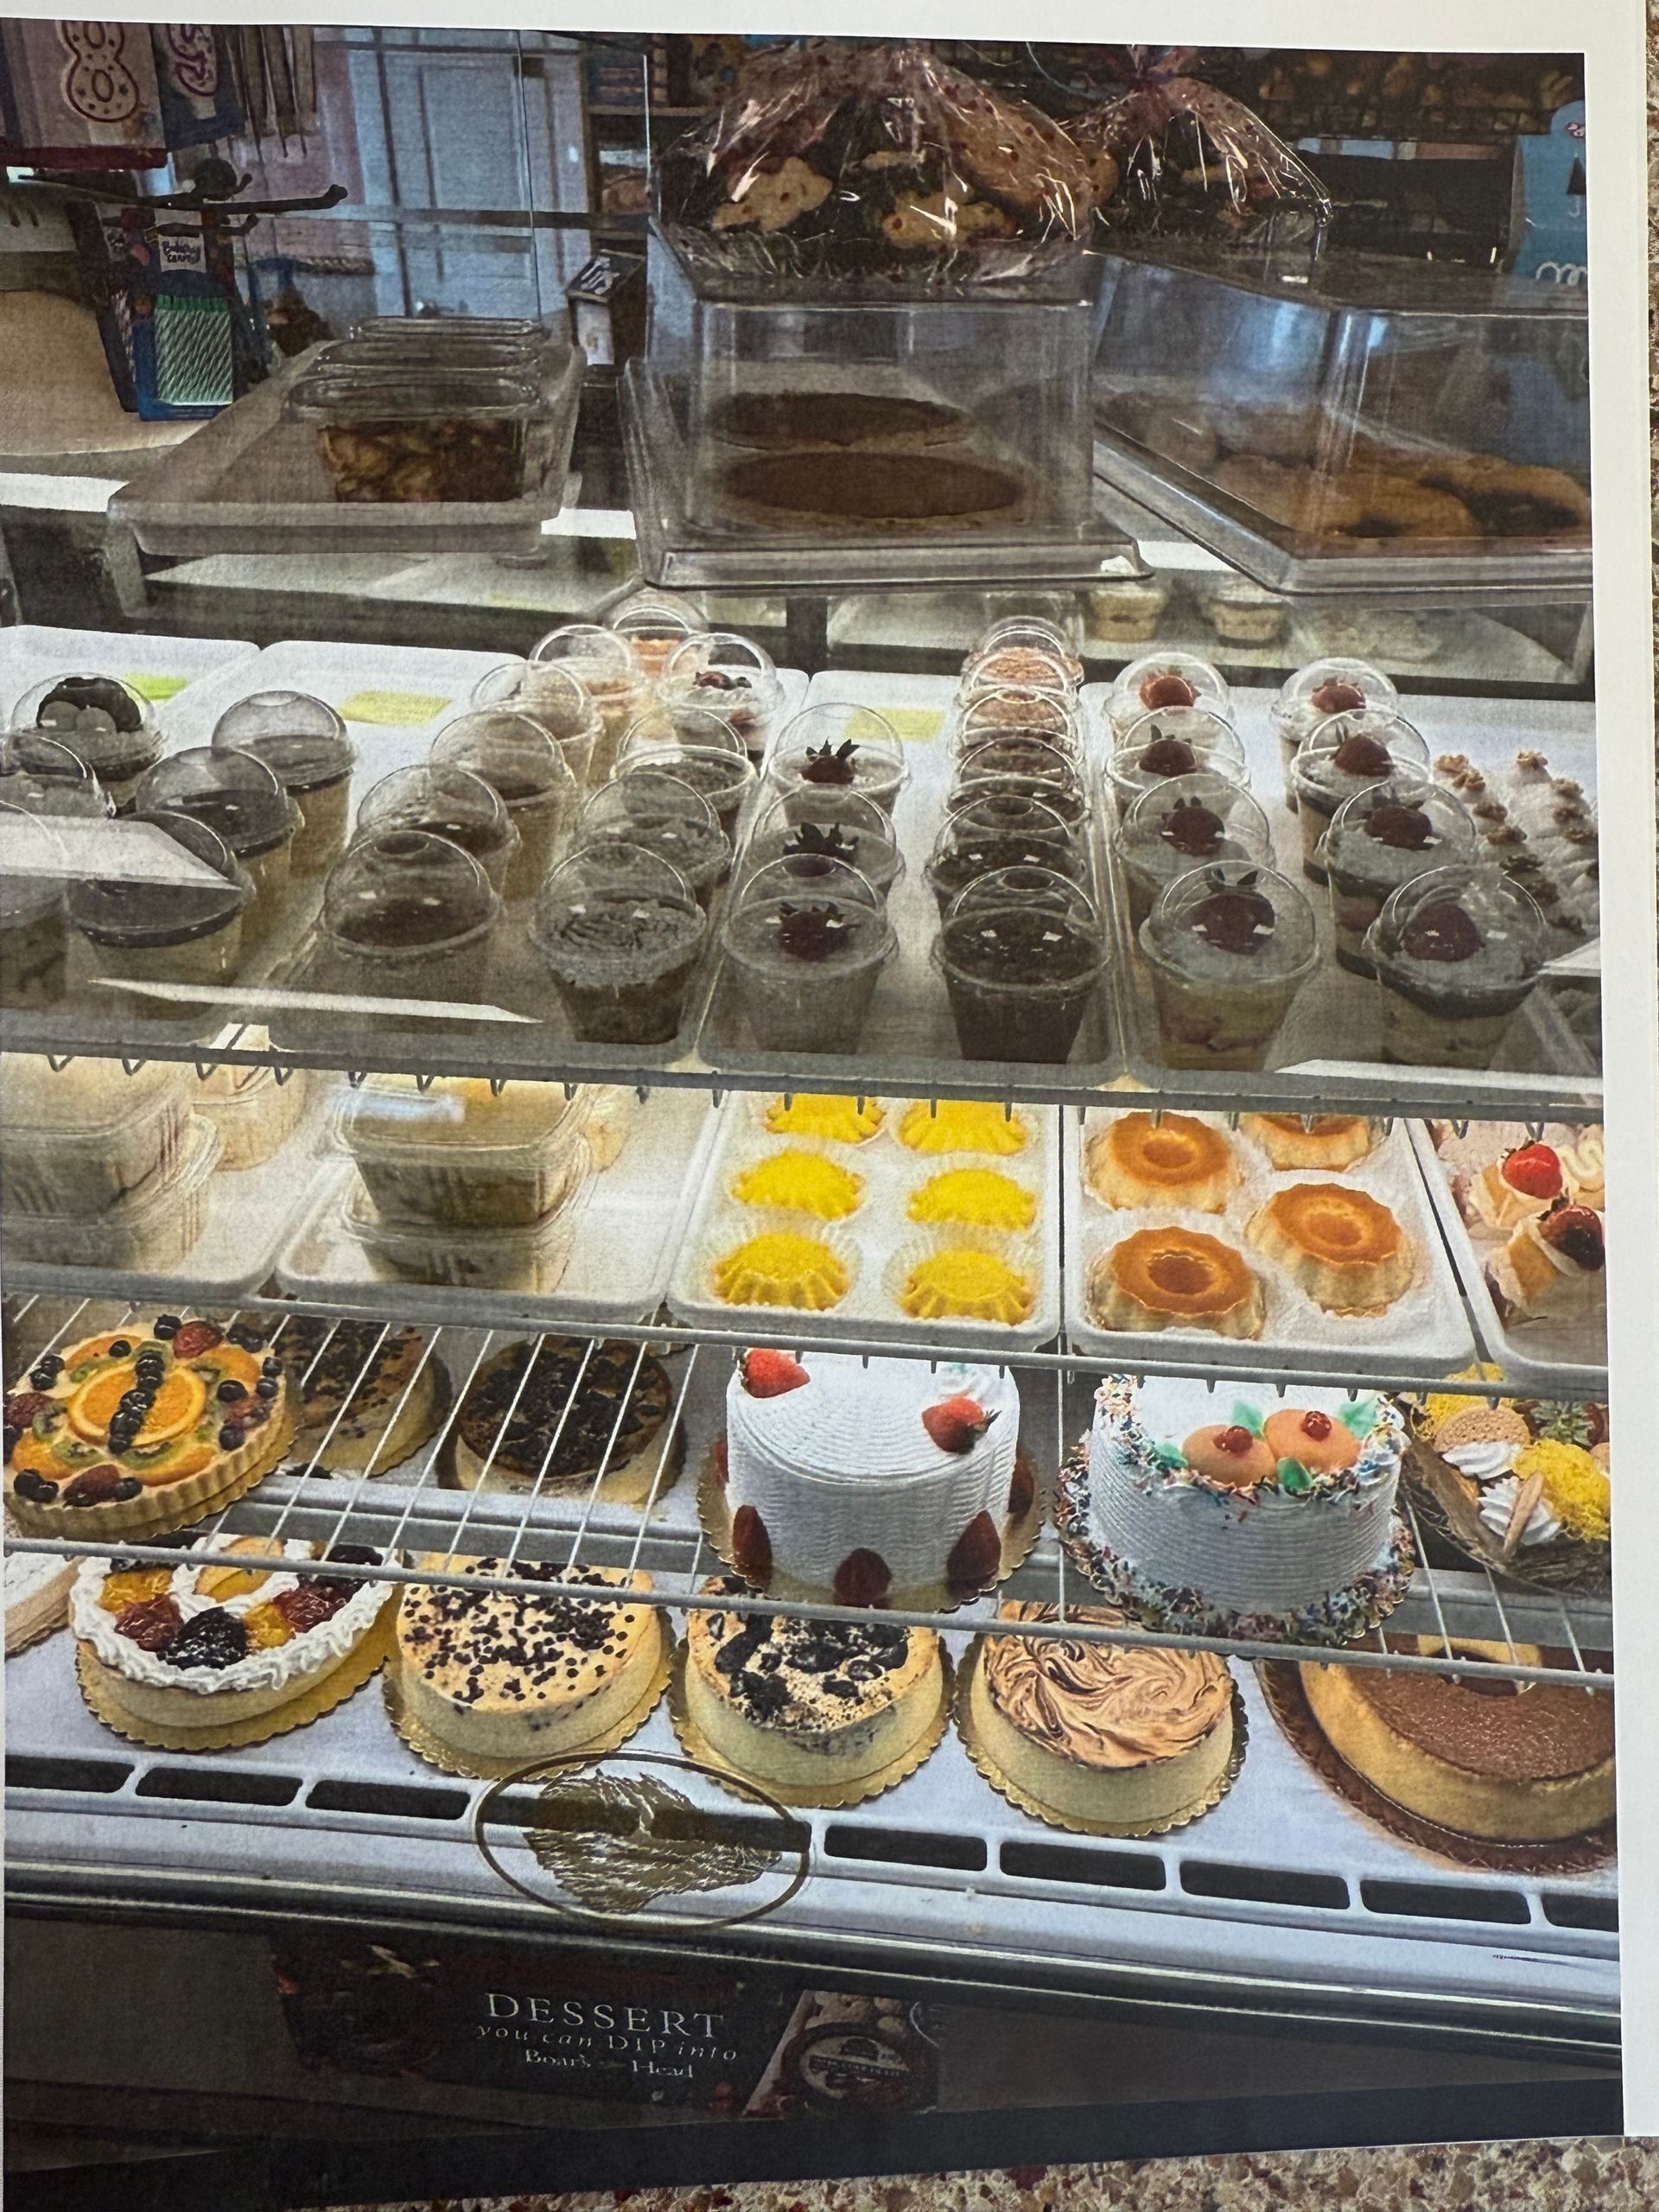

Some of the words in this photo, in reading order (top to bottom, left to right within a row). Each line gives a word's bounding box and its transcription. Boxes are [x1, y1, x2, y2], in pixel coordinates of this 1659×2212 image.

[485, 1993, 724, 2038] DESSERT
[476, 2024, 529, 2040] you
[543, 2032, 593, 2048] can
[607, 2035, 665, 2055] DIP
[677, 2040, 737, 2062] into
